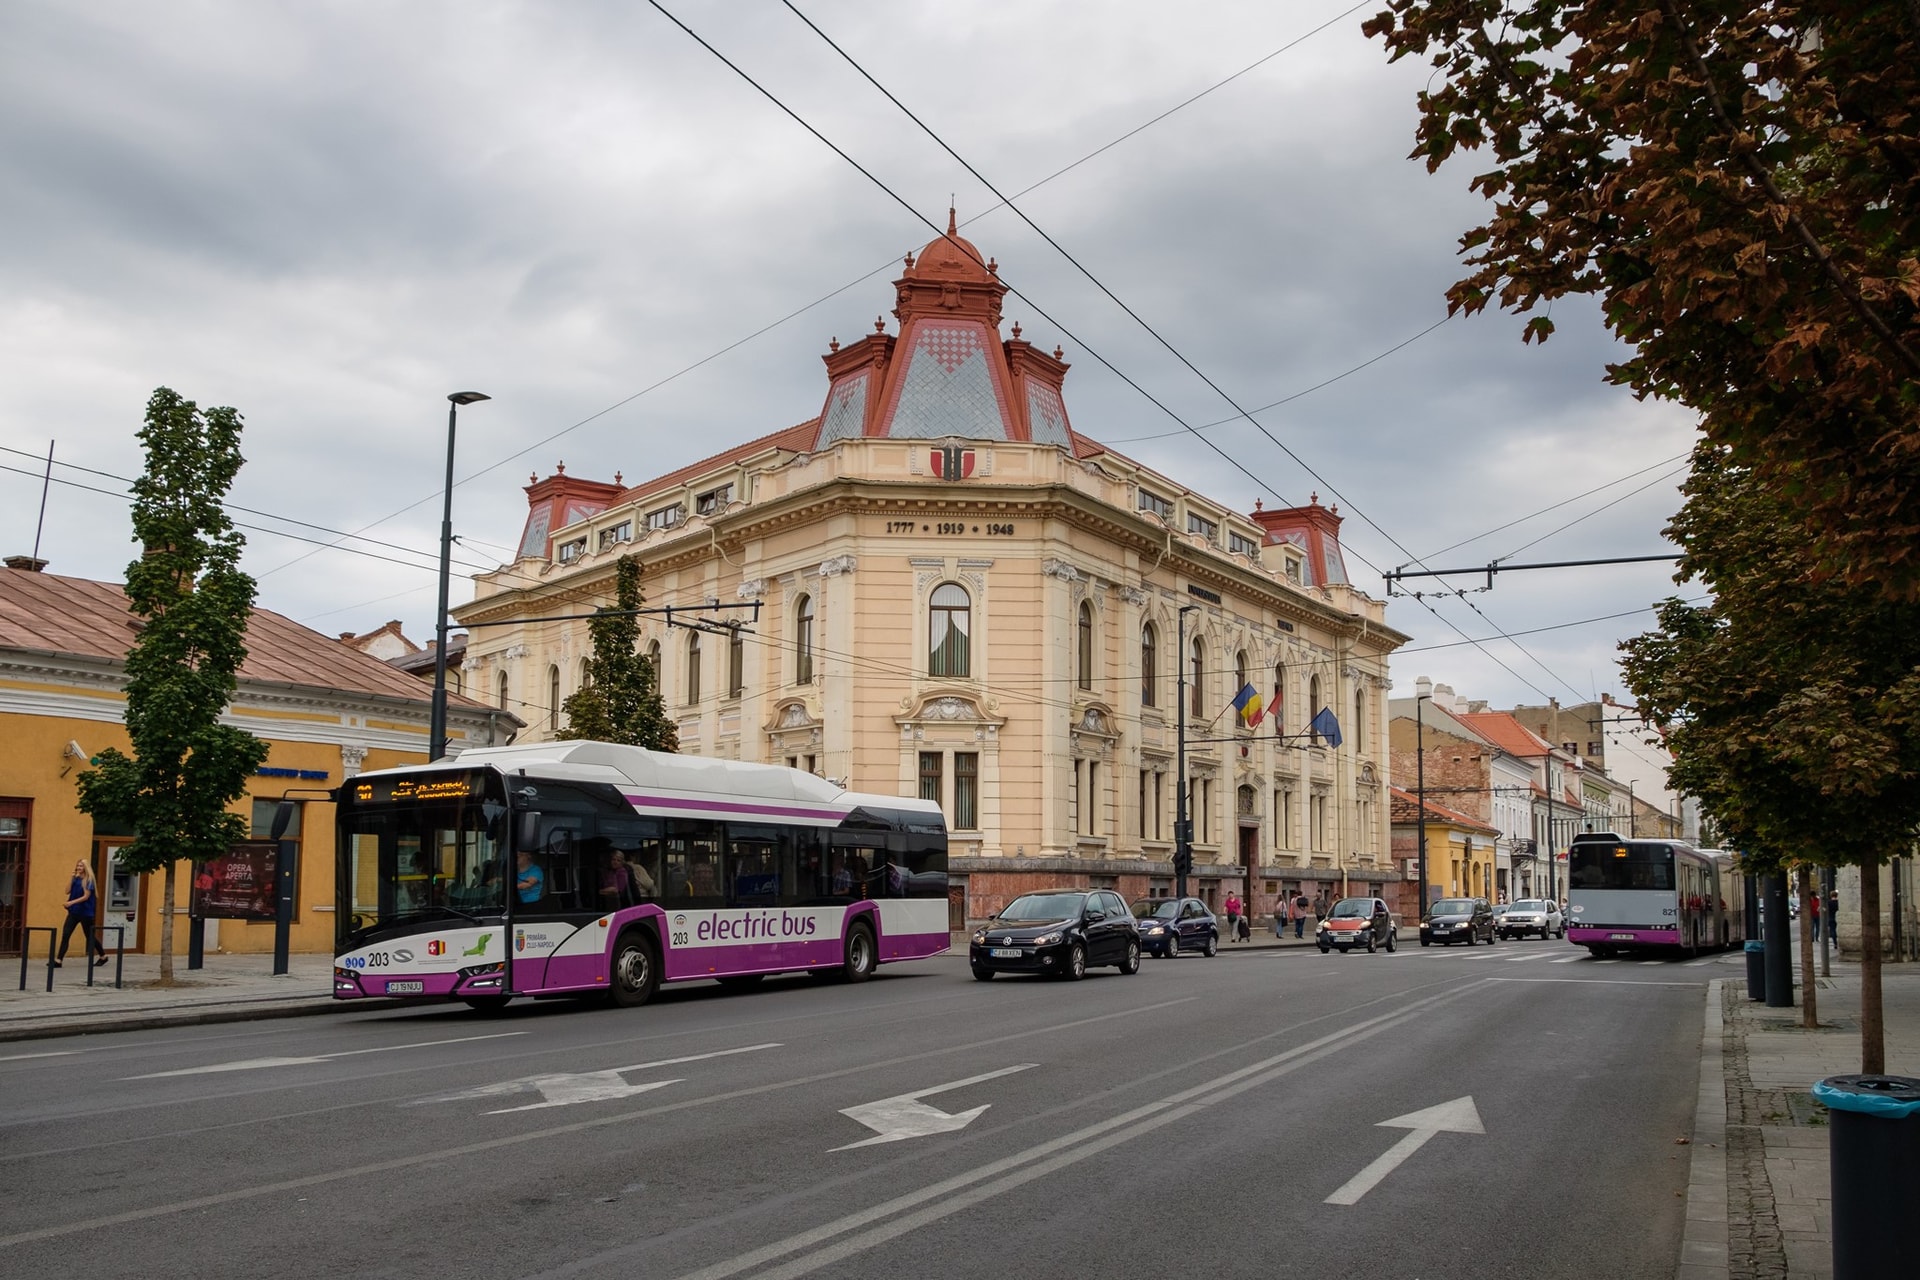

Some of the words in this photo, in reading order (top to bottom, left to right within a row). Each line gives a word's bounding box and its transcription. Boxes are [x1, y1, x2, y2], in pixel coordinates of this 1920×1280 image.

[886, 521, 915, 534] 1777
[936, 522, 965, 535] 1919
[985, 523, 1015, 536] 1948
[226, 863, 252, 872] OPERA
[225, 871, 253, 881] APERTA
[1662, 908, 1677, 916] 821
[697, 911, 778, 941] electric
[782, 910, 816, 936] bus
[672, 932, 689, 946] 203
[368, 952, 389, 967] 203
[390, 983, 399, 991] CJ
